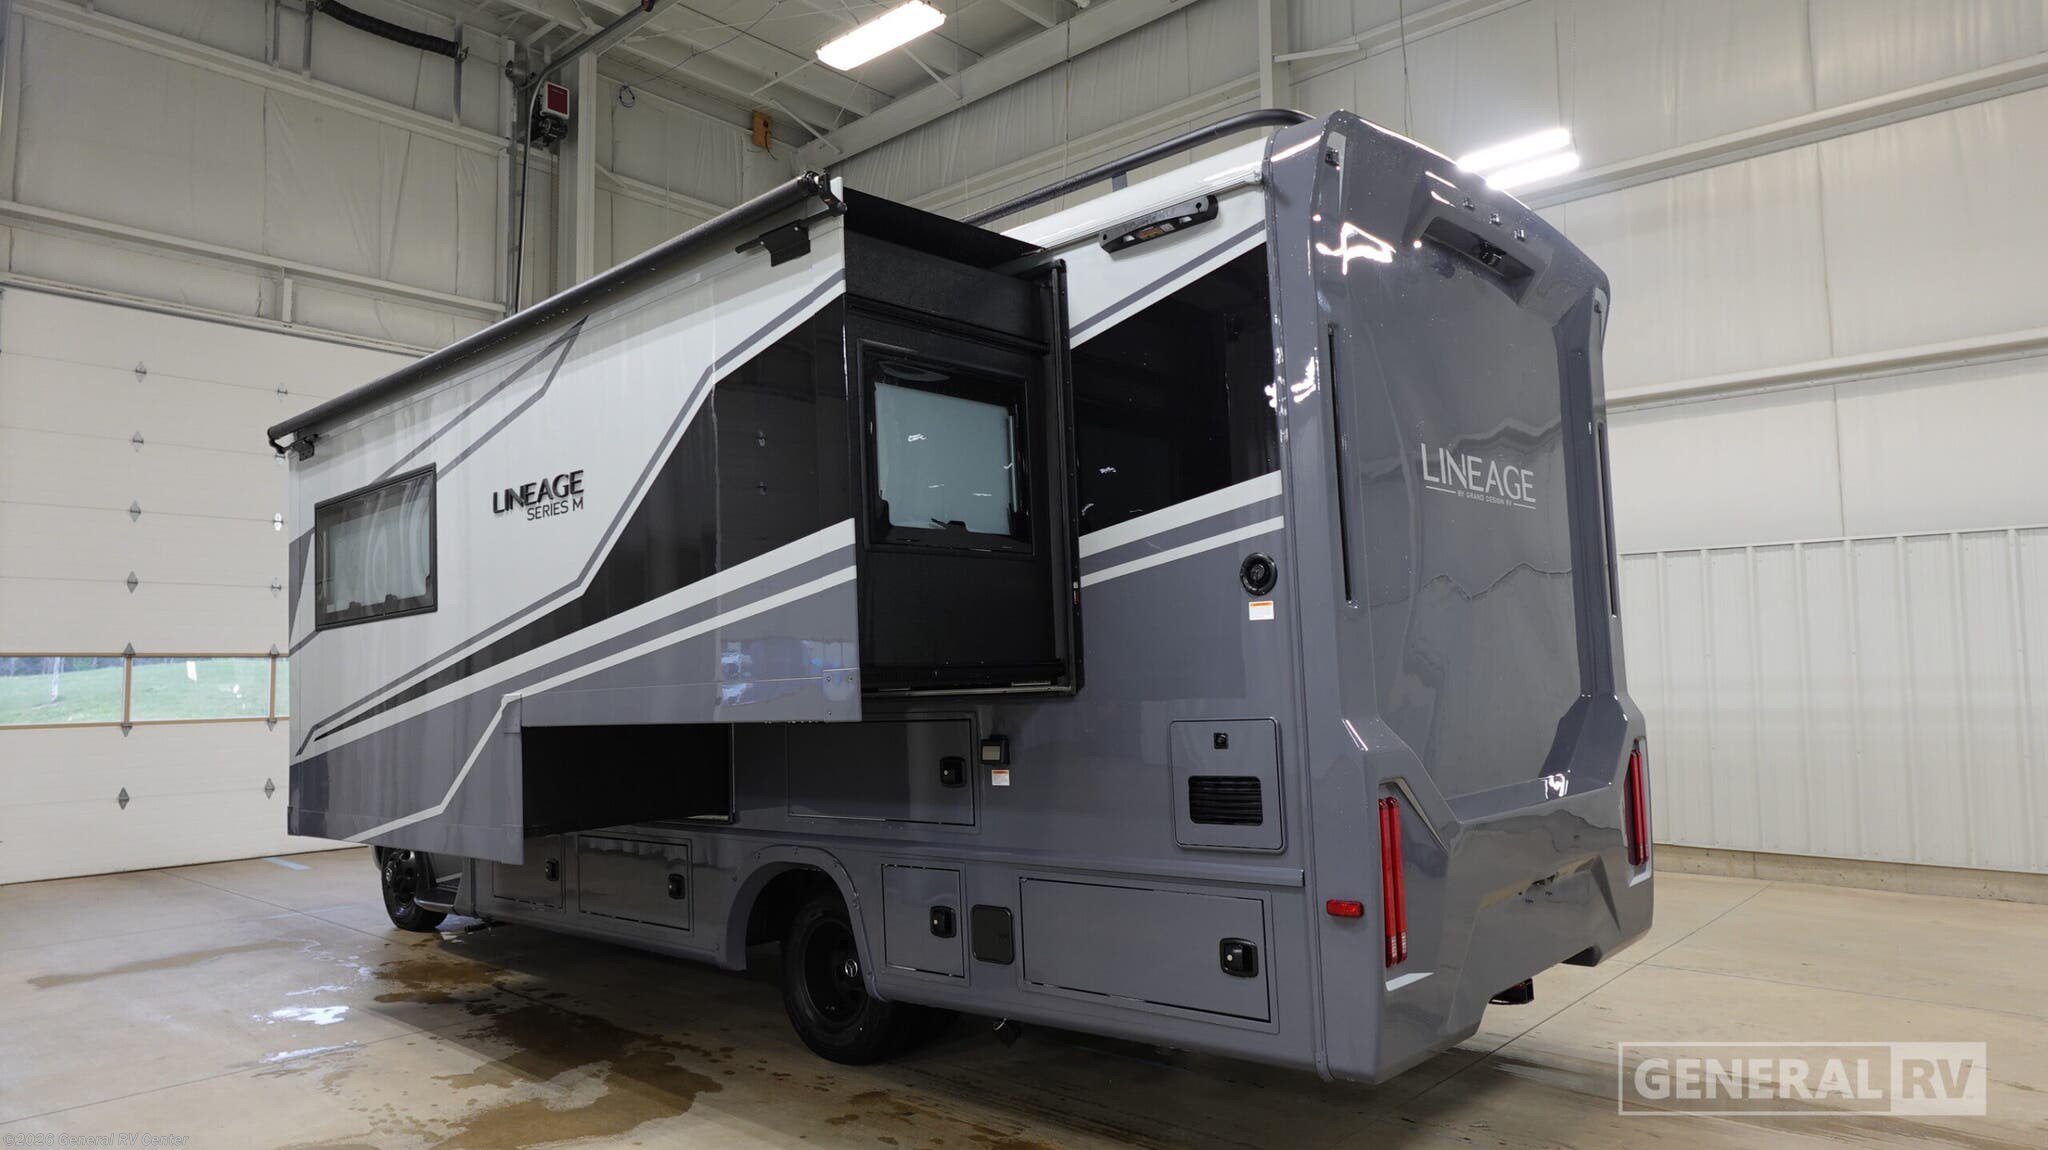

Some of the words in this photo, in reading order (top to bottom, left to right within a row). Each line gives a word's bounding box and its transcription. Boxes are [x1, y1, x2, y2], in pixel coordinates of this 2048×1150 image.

[492, 469, 584, 514] LINEAGE
[1420, 442, 1537, 503] LINEAGE
[527, 500, 569, 521] SERIES
[572, 497, 584, 512] M
